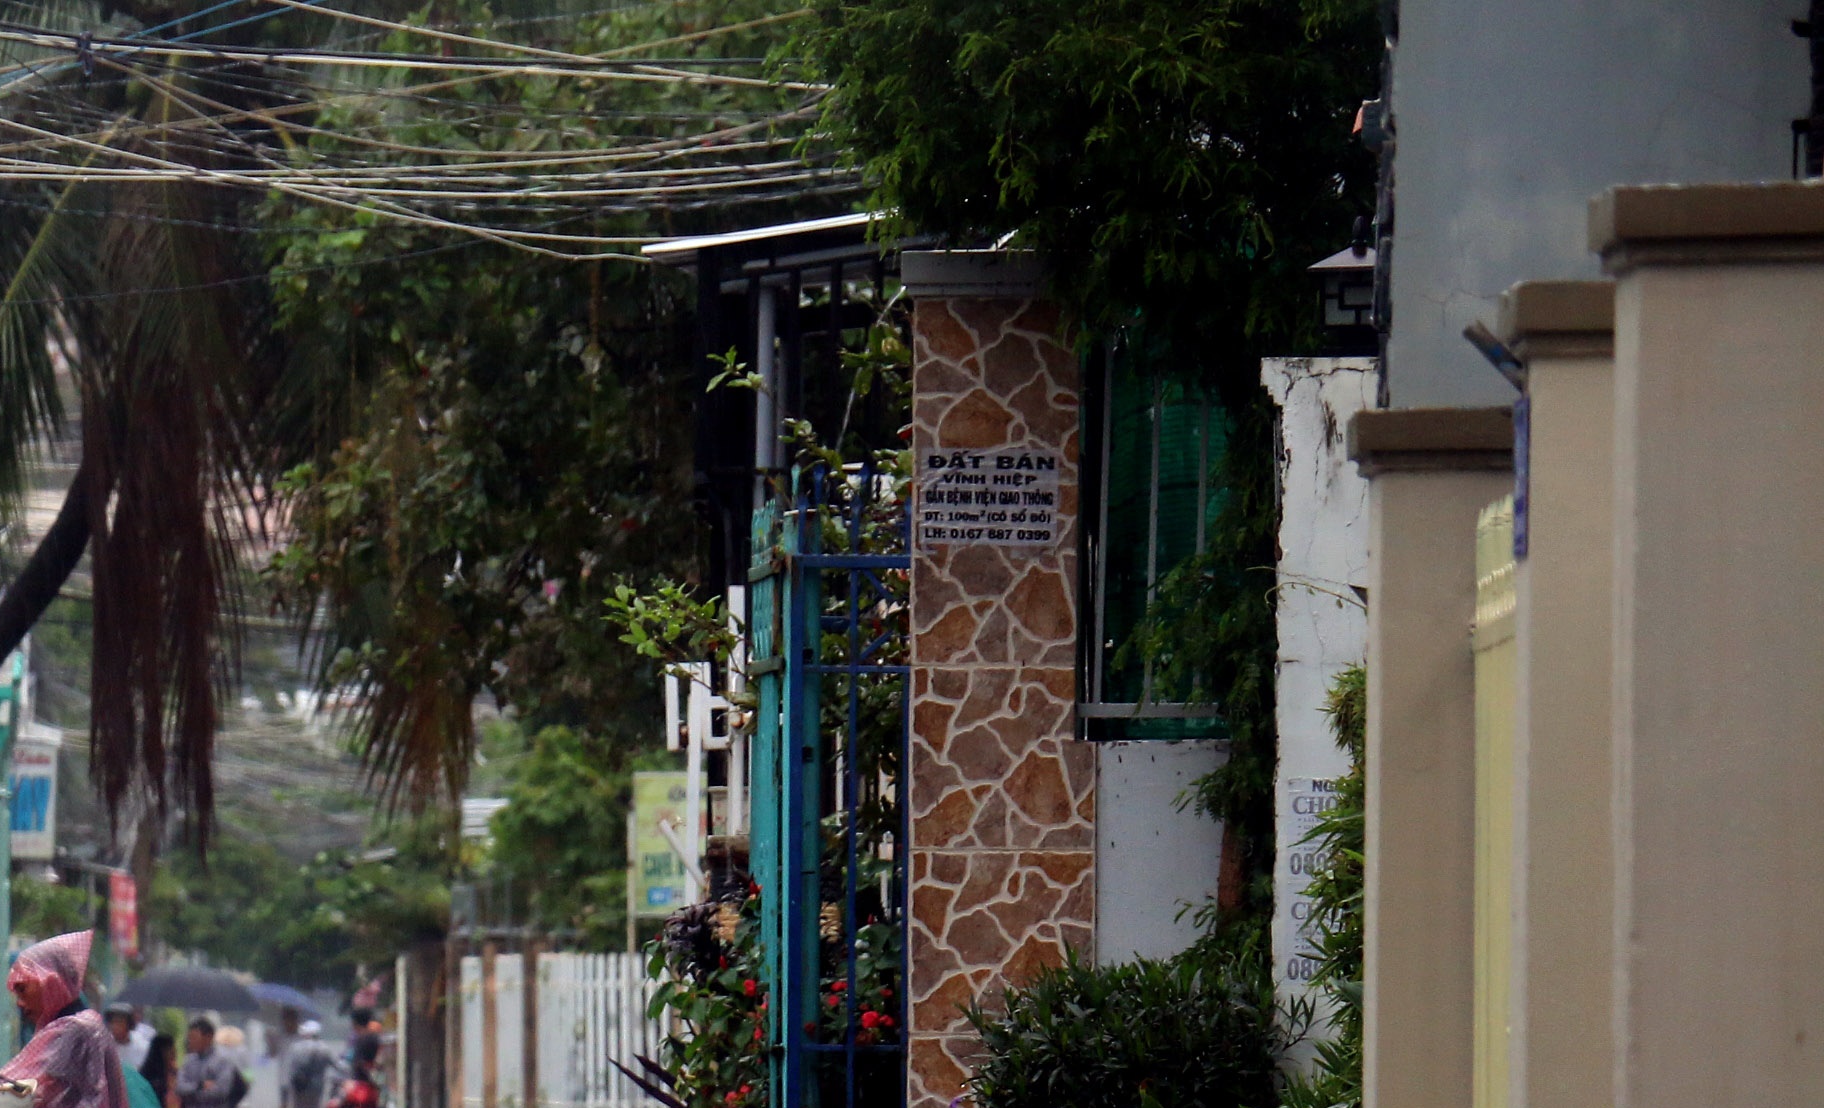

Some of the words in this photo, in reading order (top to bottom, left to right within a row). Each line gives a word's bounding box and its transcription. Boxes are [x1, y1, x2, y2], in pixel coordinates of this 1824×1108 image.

[927, 451, 985, 469] ĐẤT
[996, 453, 1056, 470] BÁN
[993, 472, 1038, 487] HIỆP
[999, 491, 1020, 505] GIAO
[924, 528, 946, 539] LH:
[950, 528, 984, 539] 0167
[988, 529, 1013, 540] 887
[1017, 530, 1051, 541] 0399
